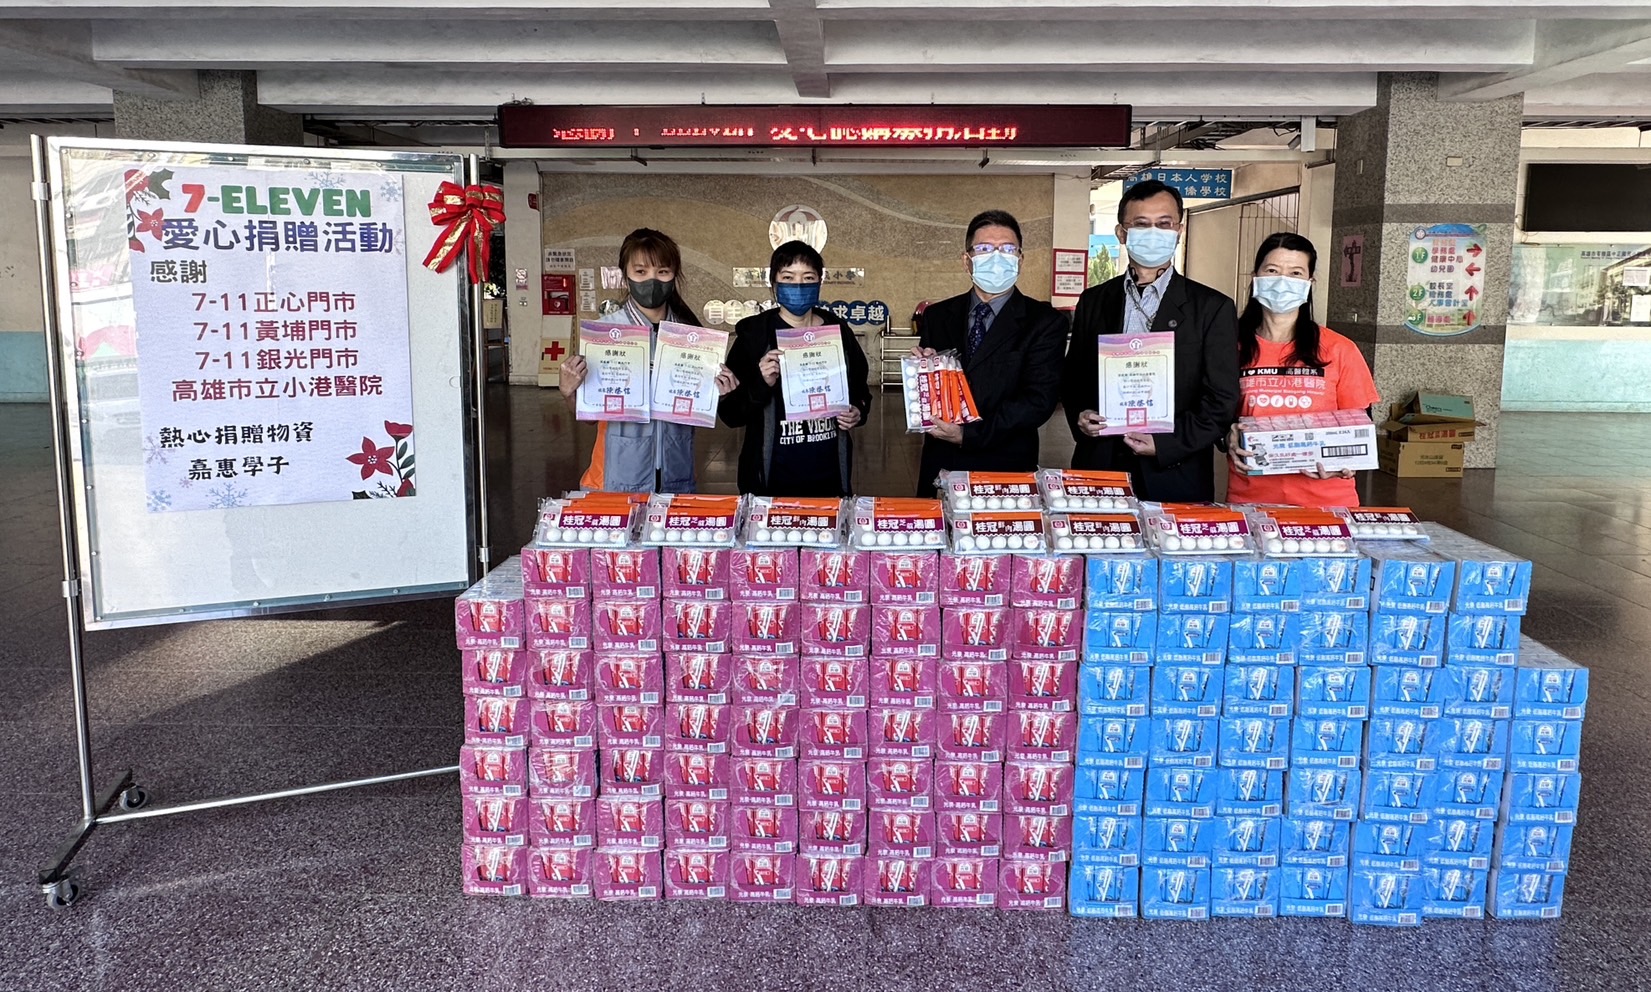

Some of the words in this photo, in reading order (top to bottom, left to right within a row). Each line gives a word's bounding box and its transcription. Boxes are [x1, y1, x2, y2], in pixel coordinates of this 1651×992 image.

[181, 183, 372, 218] 7-ELEVEN
[1176, 186, 1226, 196] 僑學校
[161, 217, 393, 253] 愛心捐贈活動
[1415, 251, 1425, 260] 1F
[150, 259, 207, 284] 感謝
[191, 291, 356, 313] 7-11正心門市
[1412, 289, 1423, 297] 2F
[193, 319, 357, 342] 7-11黃埔門市
[195, 347, 359, 370] 7-11銀光門市
[172, 374, 383, 402] 高雄市立小港醫院
[159, 421, 314, 448] 熱心捐贈物資
[780, 419, 803, 436] THE
[779, 436, 795, 445] CITY
[795, 435, 806, 443] OF
[188, 455, 290, 480] 嘉惠學子
